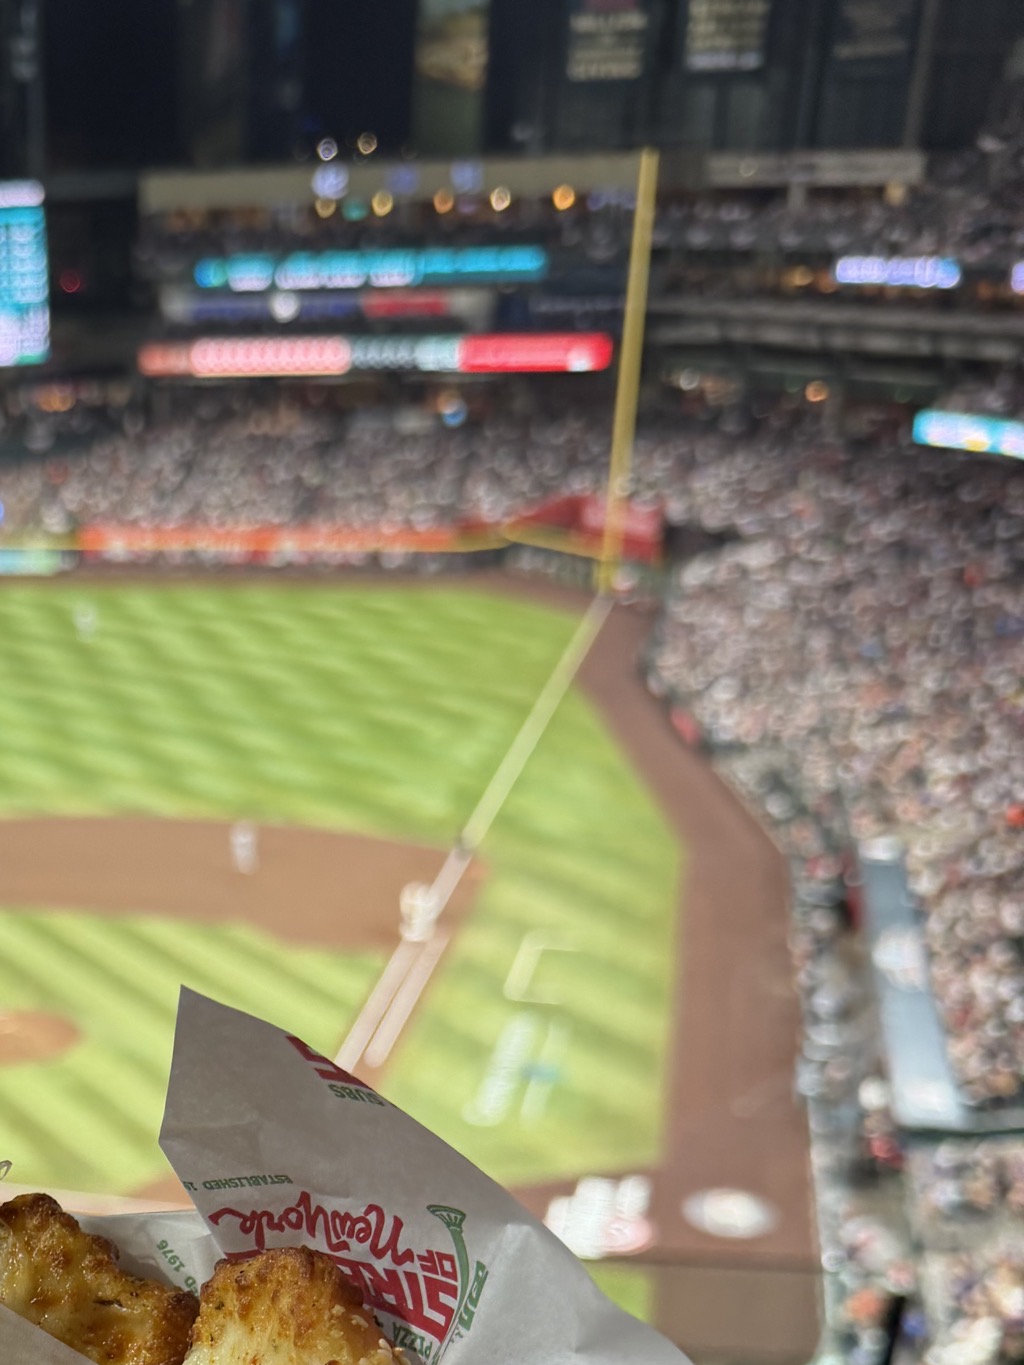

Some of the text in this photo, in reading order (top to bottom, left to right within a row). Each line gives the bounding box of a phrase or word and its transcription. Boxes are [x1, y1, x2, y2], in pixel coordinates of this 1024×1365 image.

[202, 1174, 293, 1191] ESTABLISHED
[208, 1191, 458, 1283] OF New York
[155, 1239, 185, 1274] 1976
[393, 1322, 431, 1359] PIZZA
